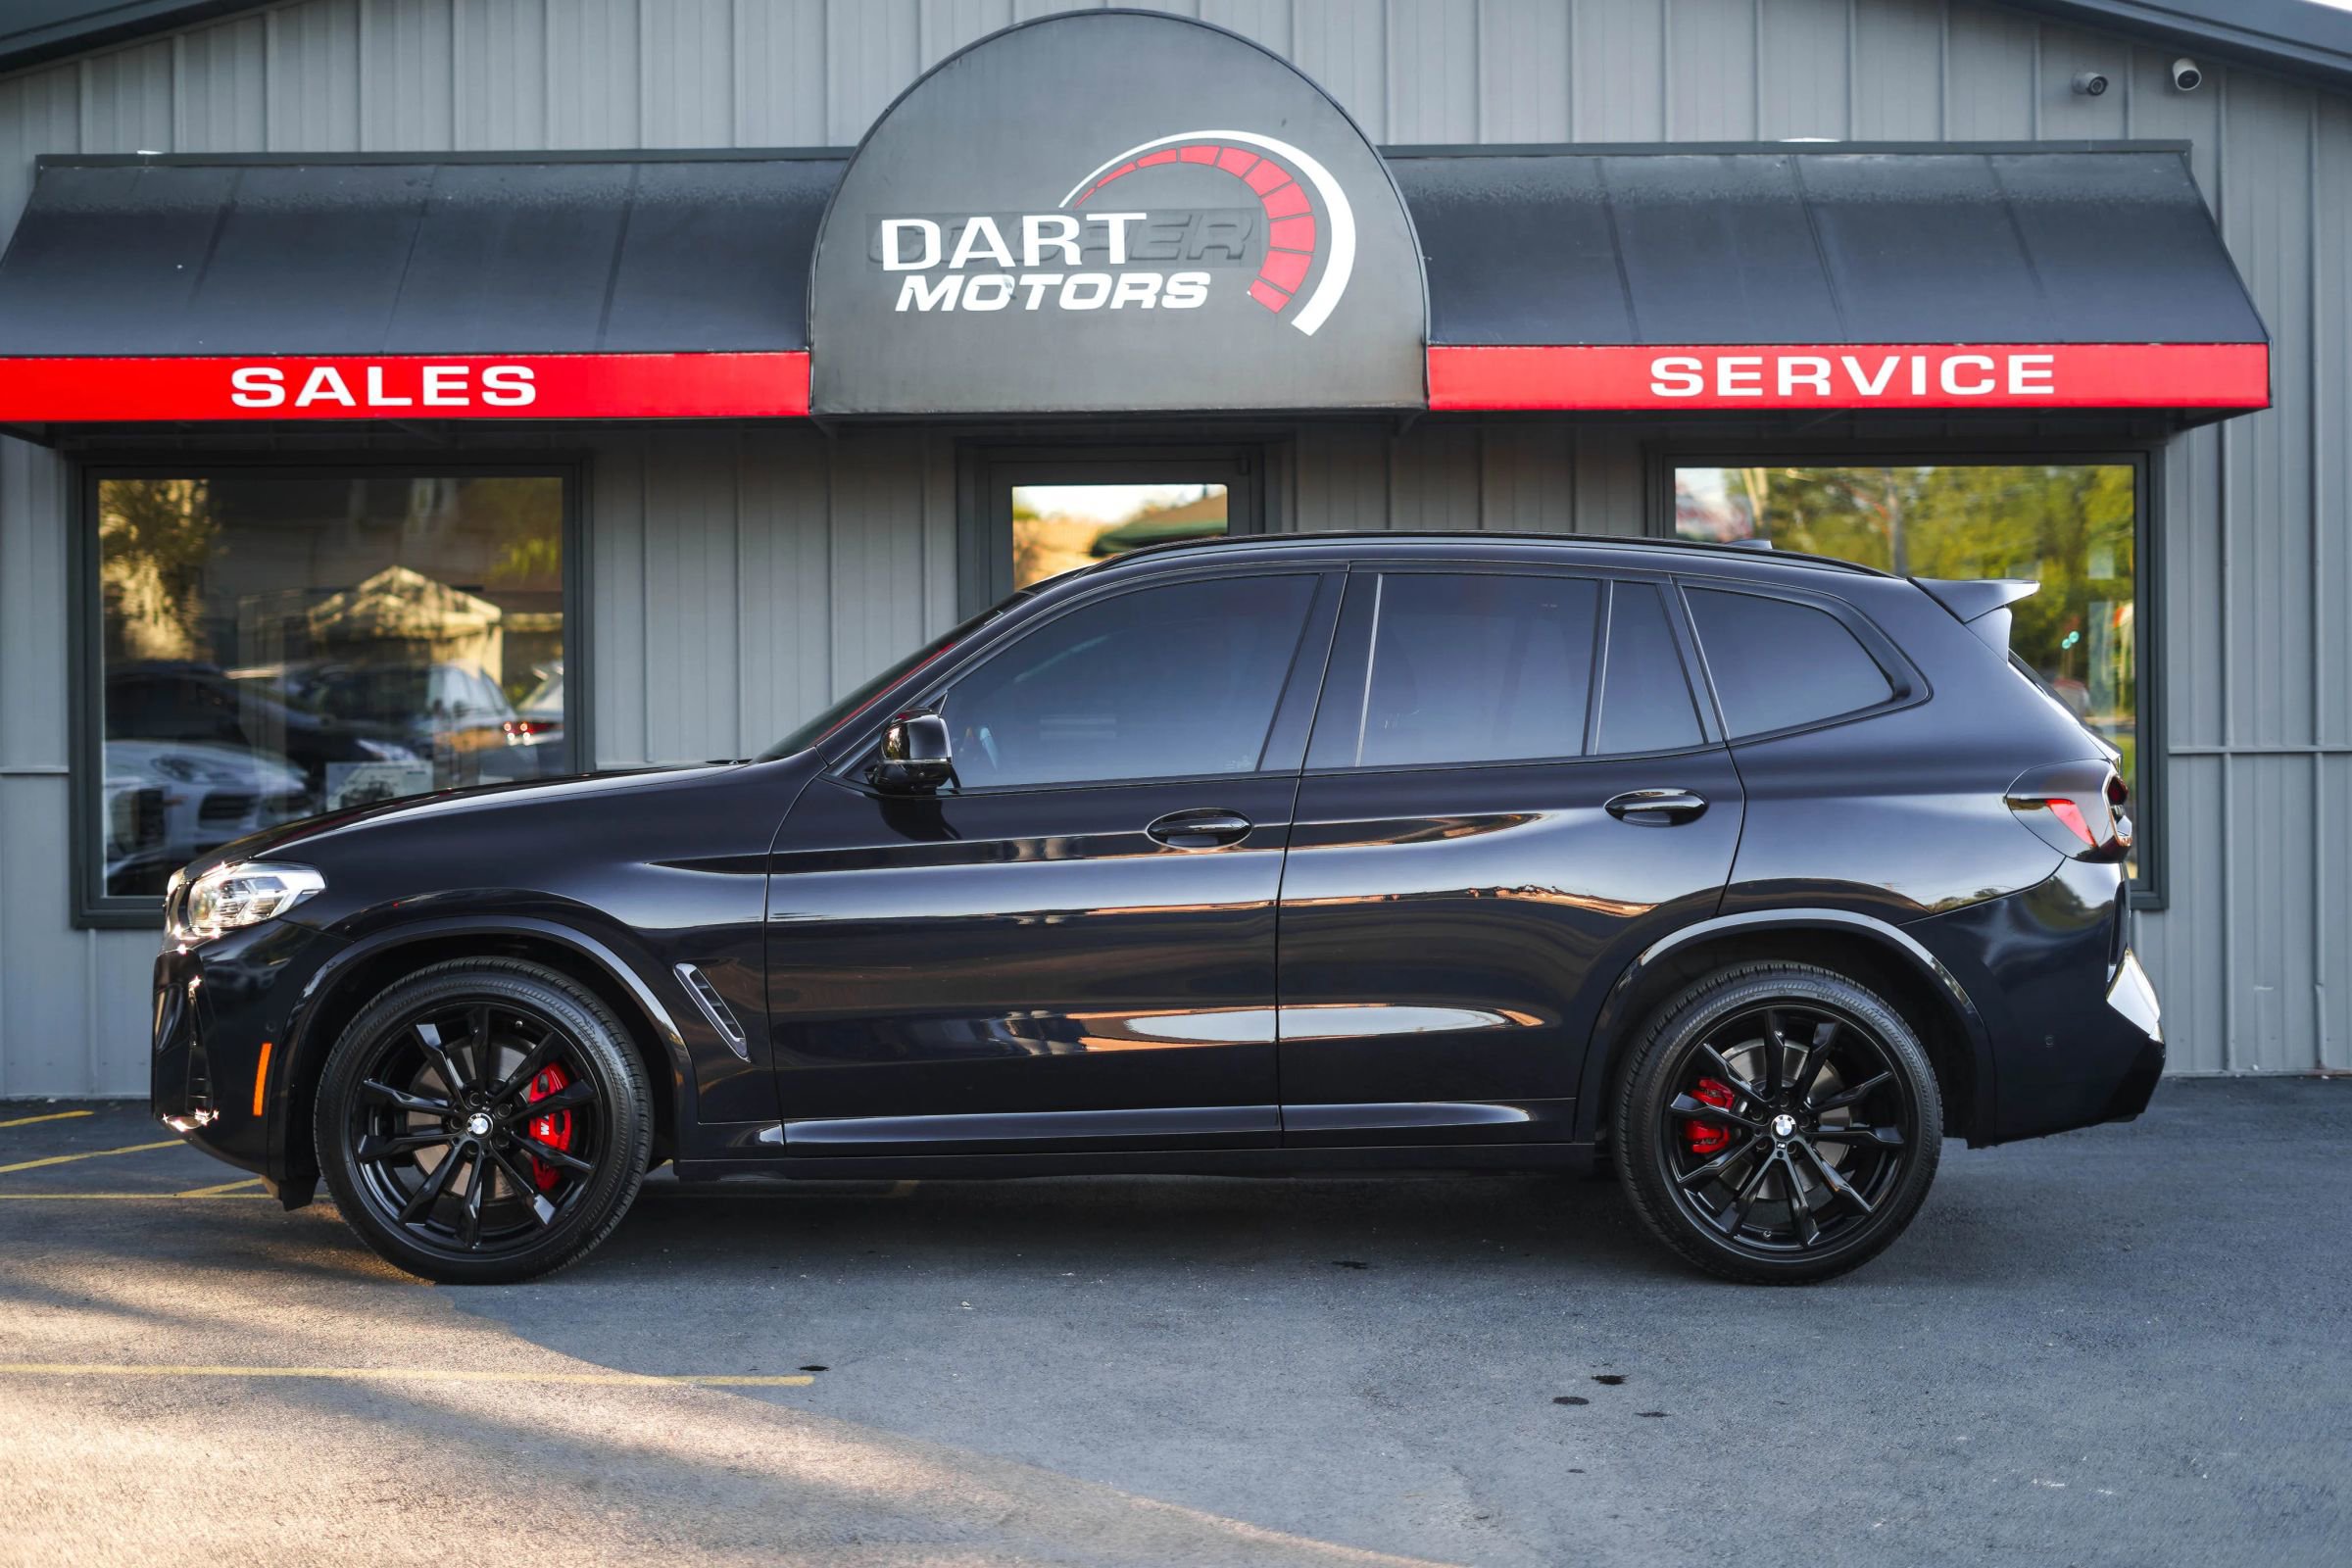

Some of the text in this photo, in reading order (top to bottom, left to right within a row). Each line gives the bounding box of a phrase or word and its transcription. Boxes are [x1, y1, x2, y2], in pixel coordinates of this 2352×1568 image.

[881, 212, 1147, 271] DART
[895, 271, 1211, 312] MOTORS
[231, 366, 537, 408] SALES
[1650, 354, 2055, 398] SERVICE
